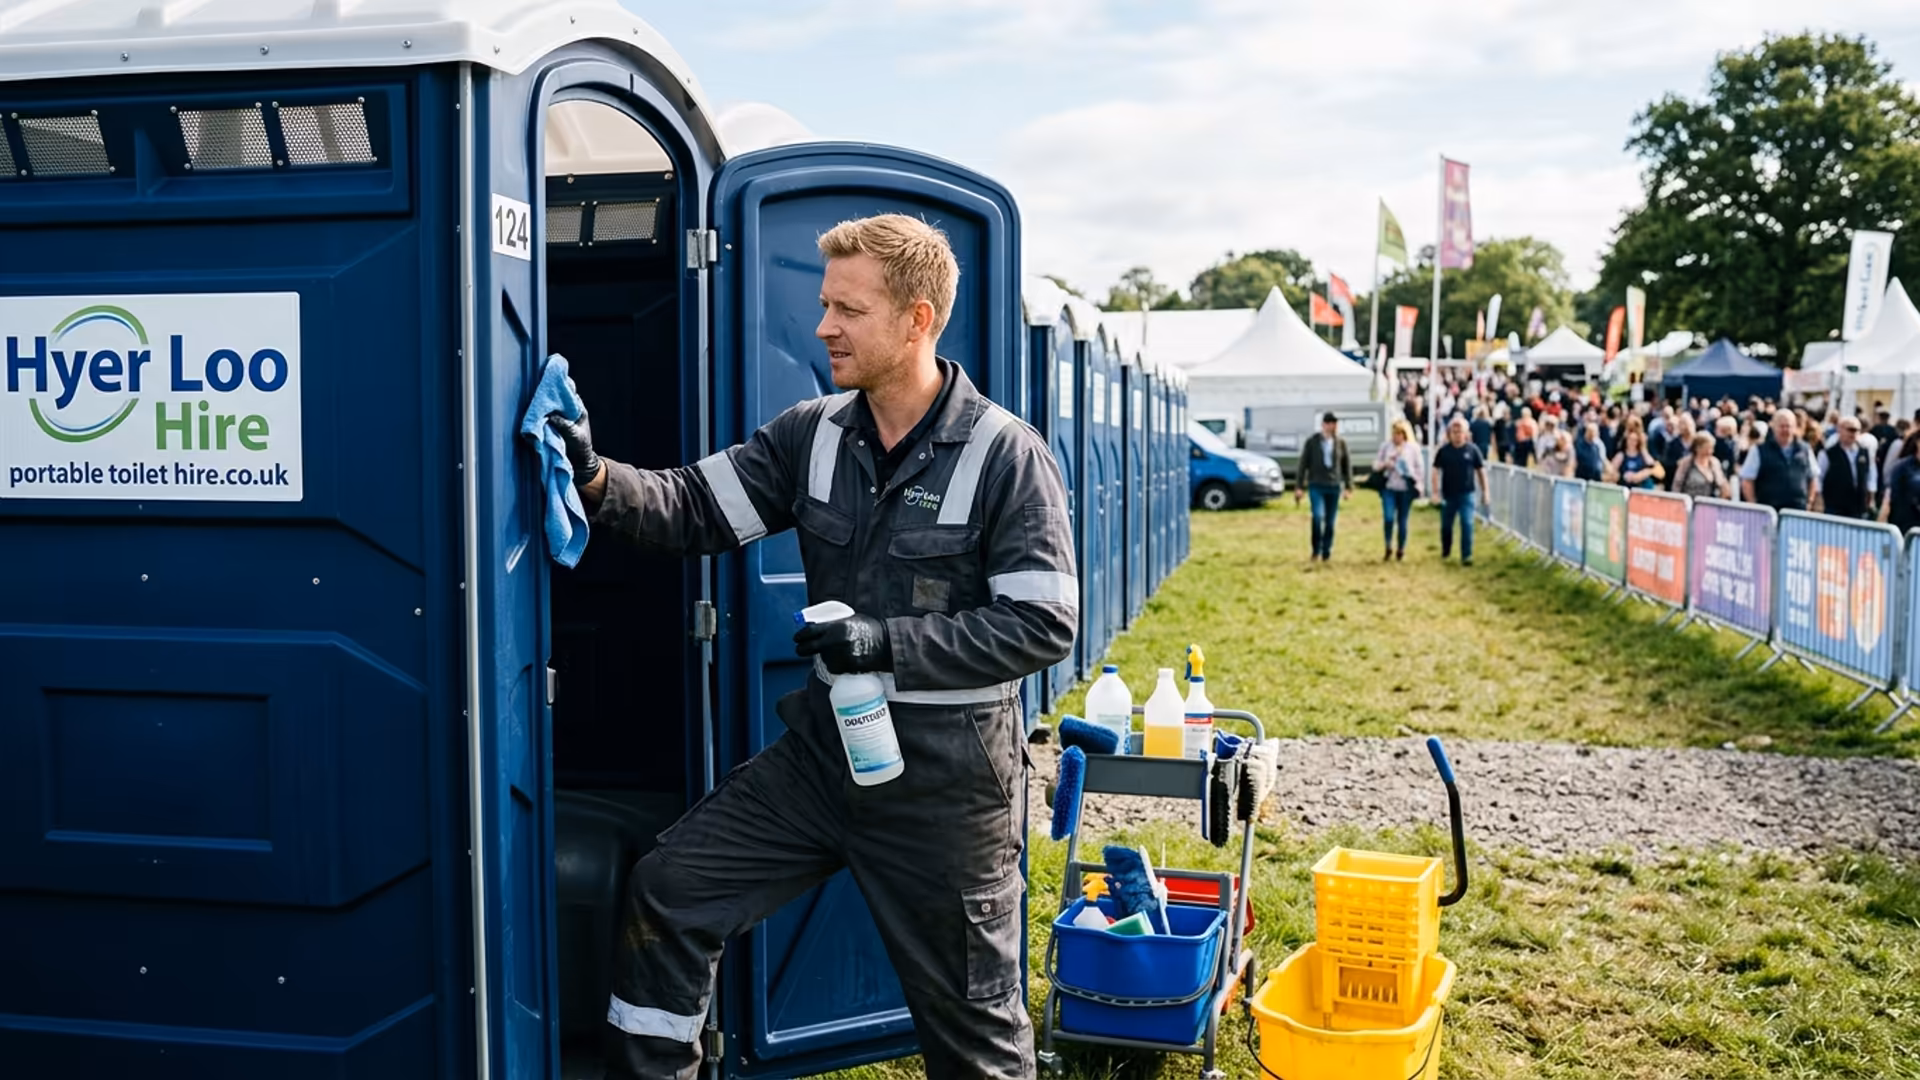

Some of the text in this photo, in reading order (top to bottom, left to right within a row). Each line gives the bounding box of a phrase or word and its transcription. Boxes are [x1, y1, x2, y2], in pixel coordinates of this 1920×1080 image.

[495, 205, 528, 251] 124
[6, 335, 288, 410] Hyer Loo
[155, 400, 270, 451] Hire
[9, 462, 289, 487] portable toilet hire.co.uk
